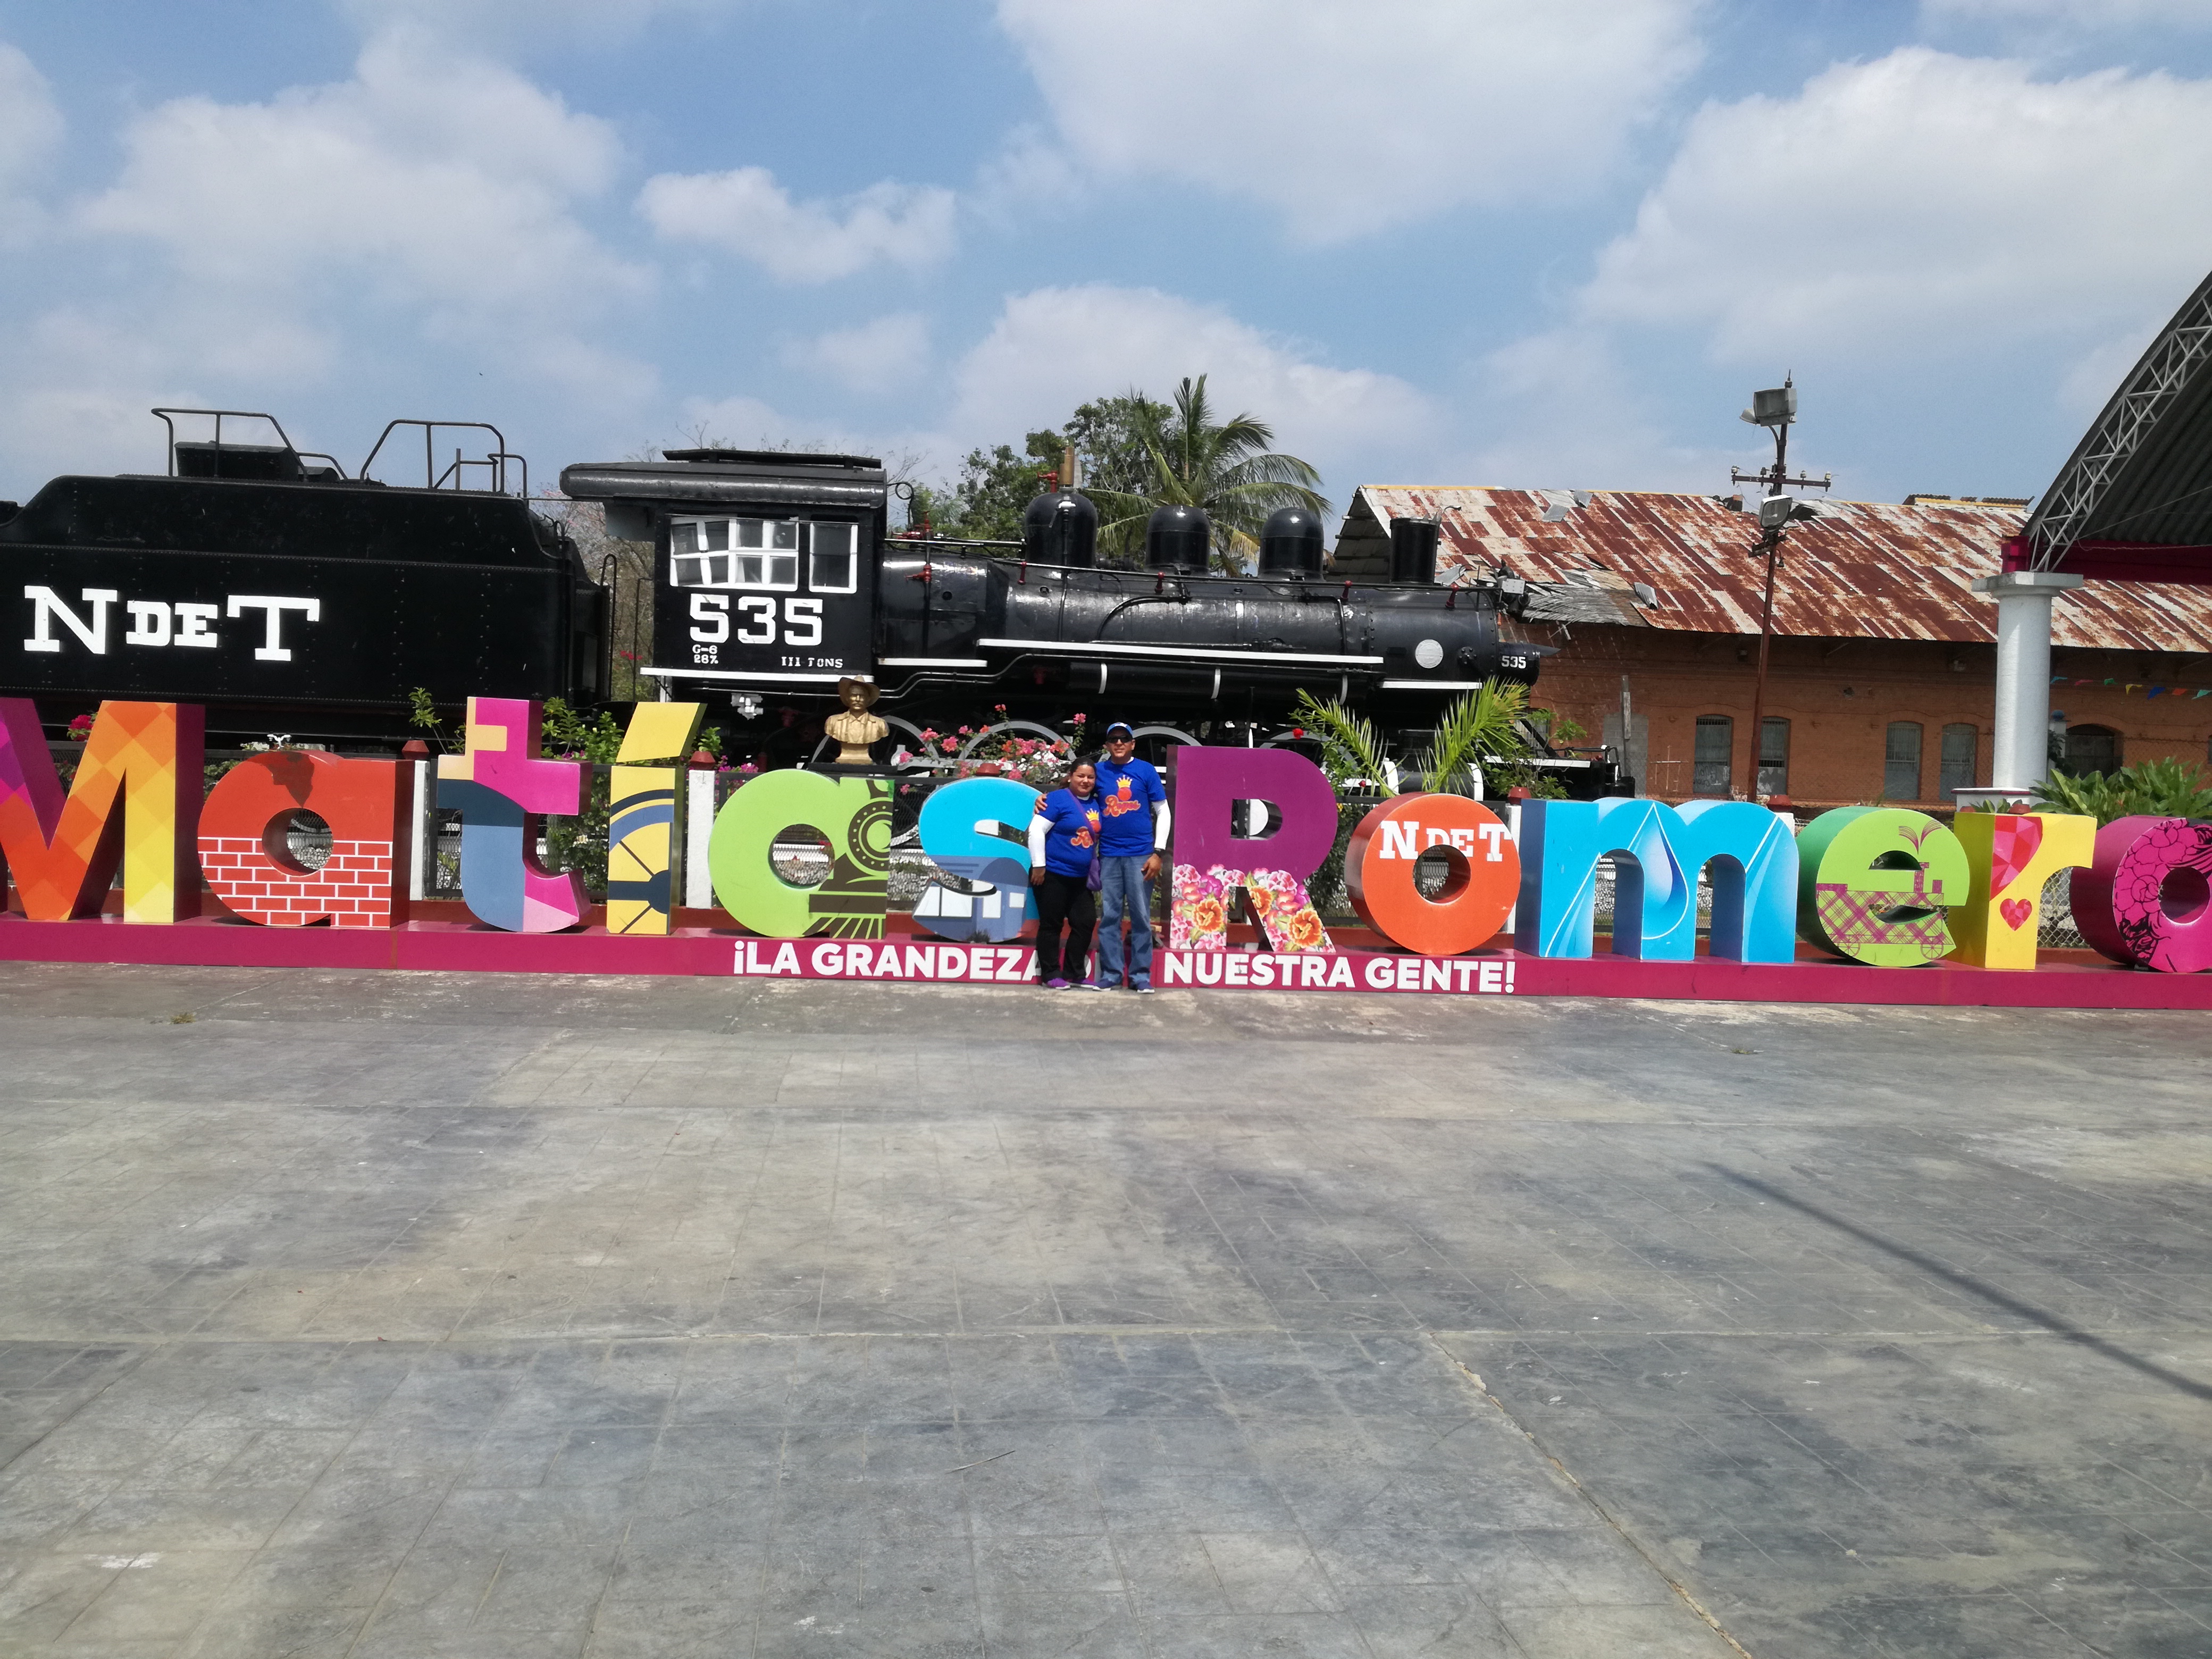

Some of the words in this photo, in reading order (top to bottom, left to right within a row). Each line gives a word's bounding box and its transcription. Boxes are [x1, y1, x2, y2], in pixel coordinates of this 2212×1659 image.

[690, 593, 823, 646] 535
[694, 654, 719, 664] 28%
[808, 657, 843, 668] TONS
[1501, 656, 1527, 669] 535
[1164, 951, 1356, 988] NUESTRA
[1365, 959, 1516, 994] GENTE!
